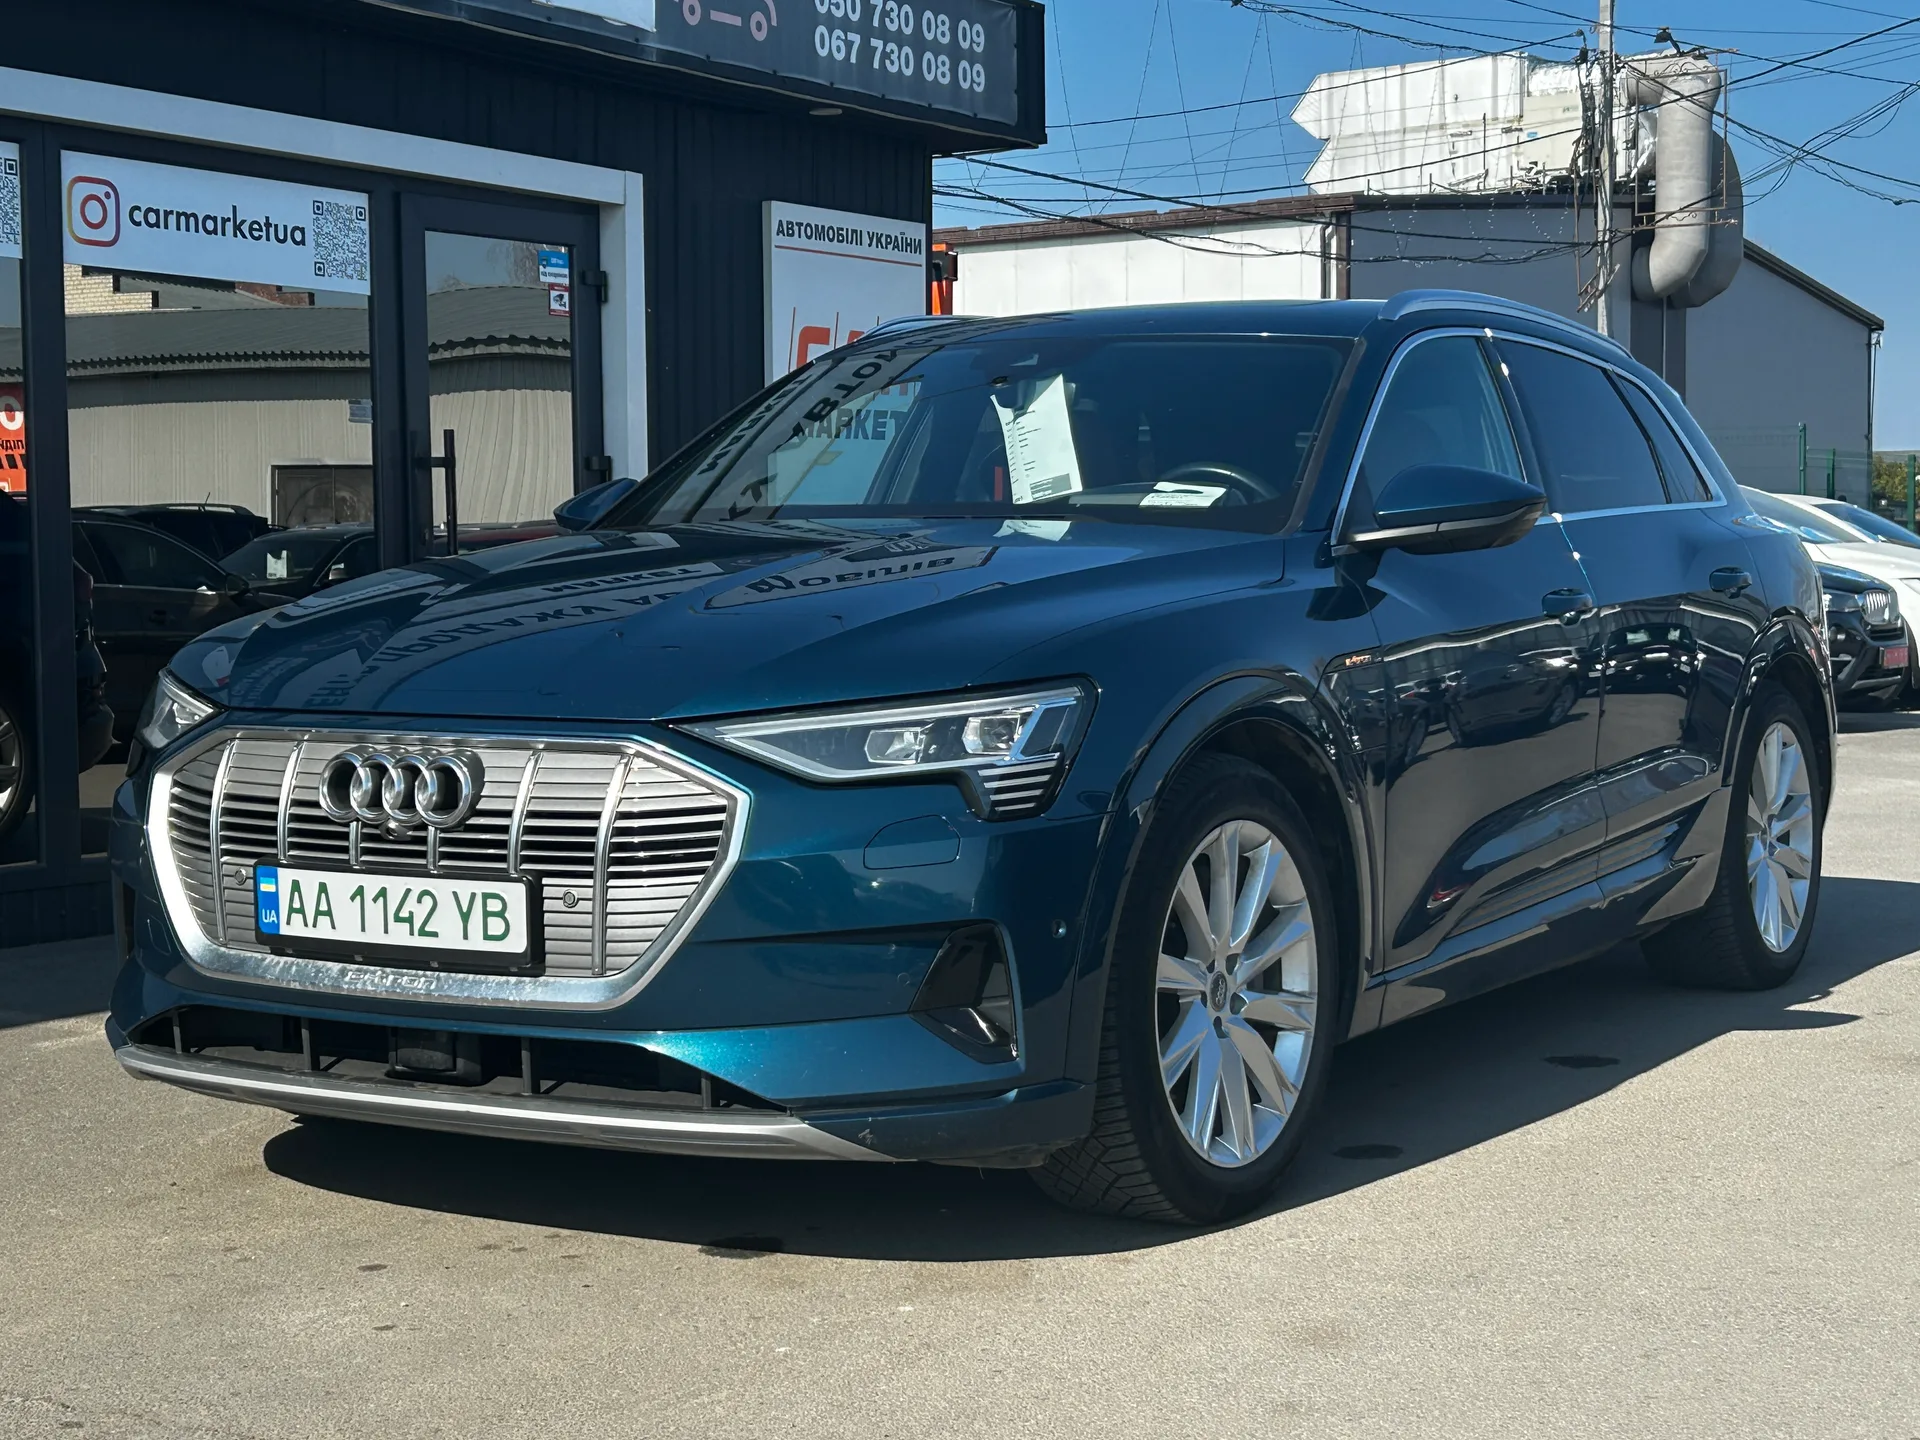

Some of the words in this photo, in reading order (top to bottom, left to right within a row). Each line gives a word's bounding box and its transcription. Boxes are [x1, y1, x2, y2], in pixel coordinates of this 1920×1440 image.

[870, 0, 914, 35] 730
[922, 10, 950, 44] 08
[957, 19, 985, 53] 09
[814, 25, 861, 64] 067
[870, 38, 914, 76] 730
[922, 51, 950, 85] 08
[957, 60, 985, 92] 09
[128, 204, 307, 247] carmarketua
[776, 219, 863, 246] АВТОМОБІЛІ
[867, 230, 922, 255] УКРАЇНИ
[262, 908, 277, 924] UA
[286, 879, 336, 930] AA
[350, 885, 439, 938] 1142
[452, 890, 511, 942] YB
